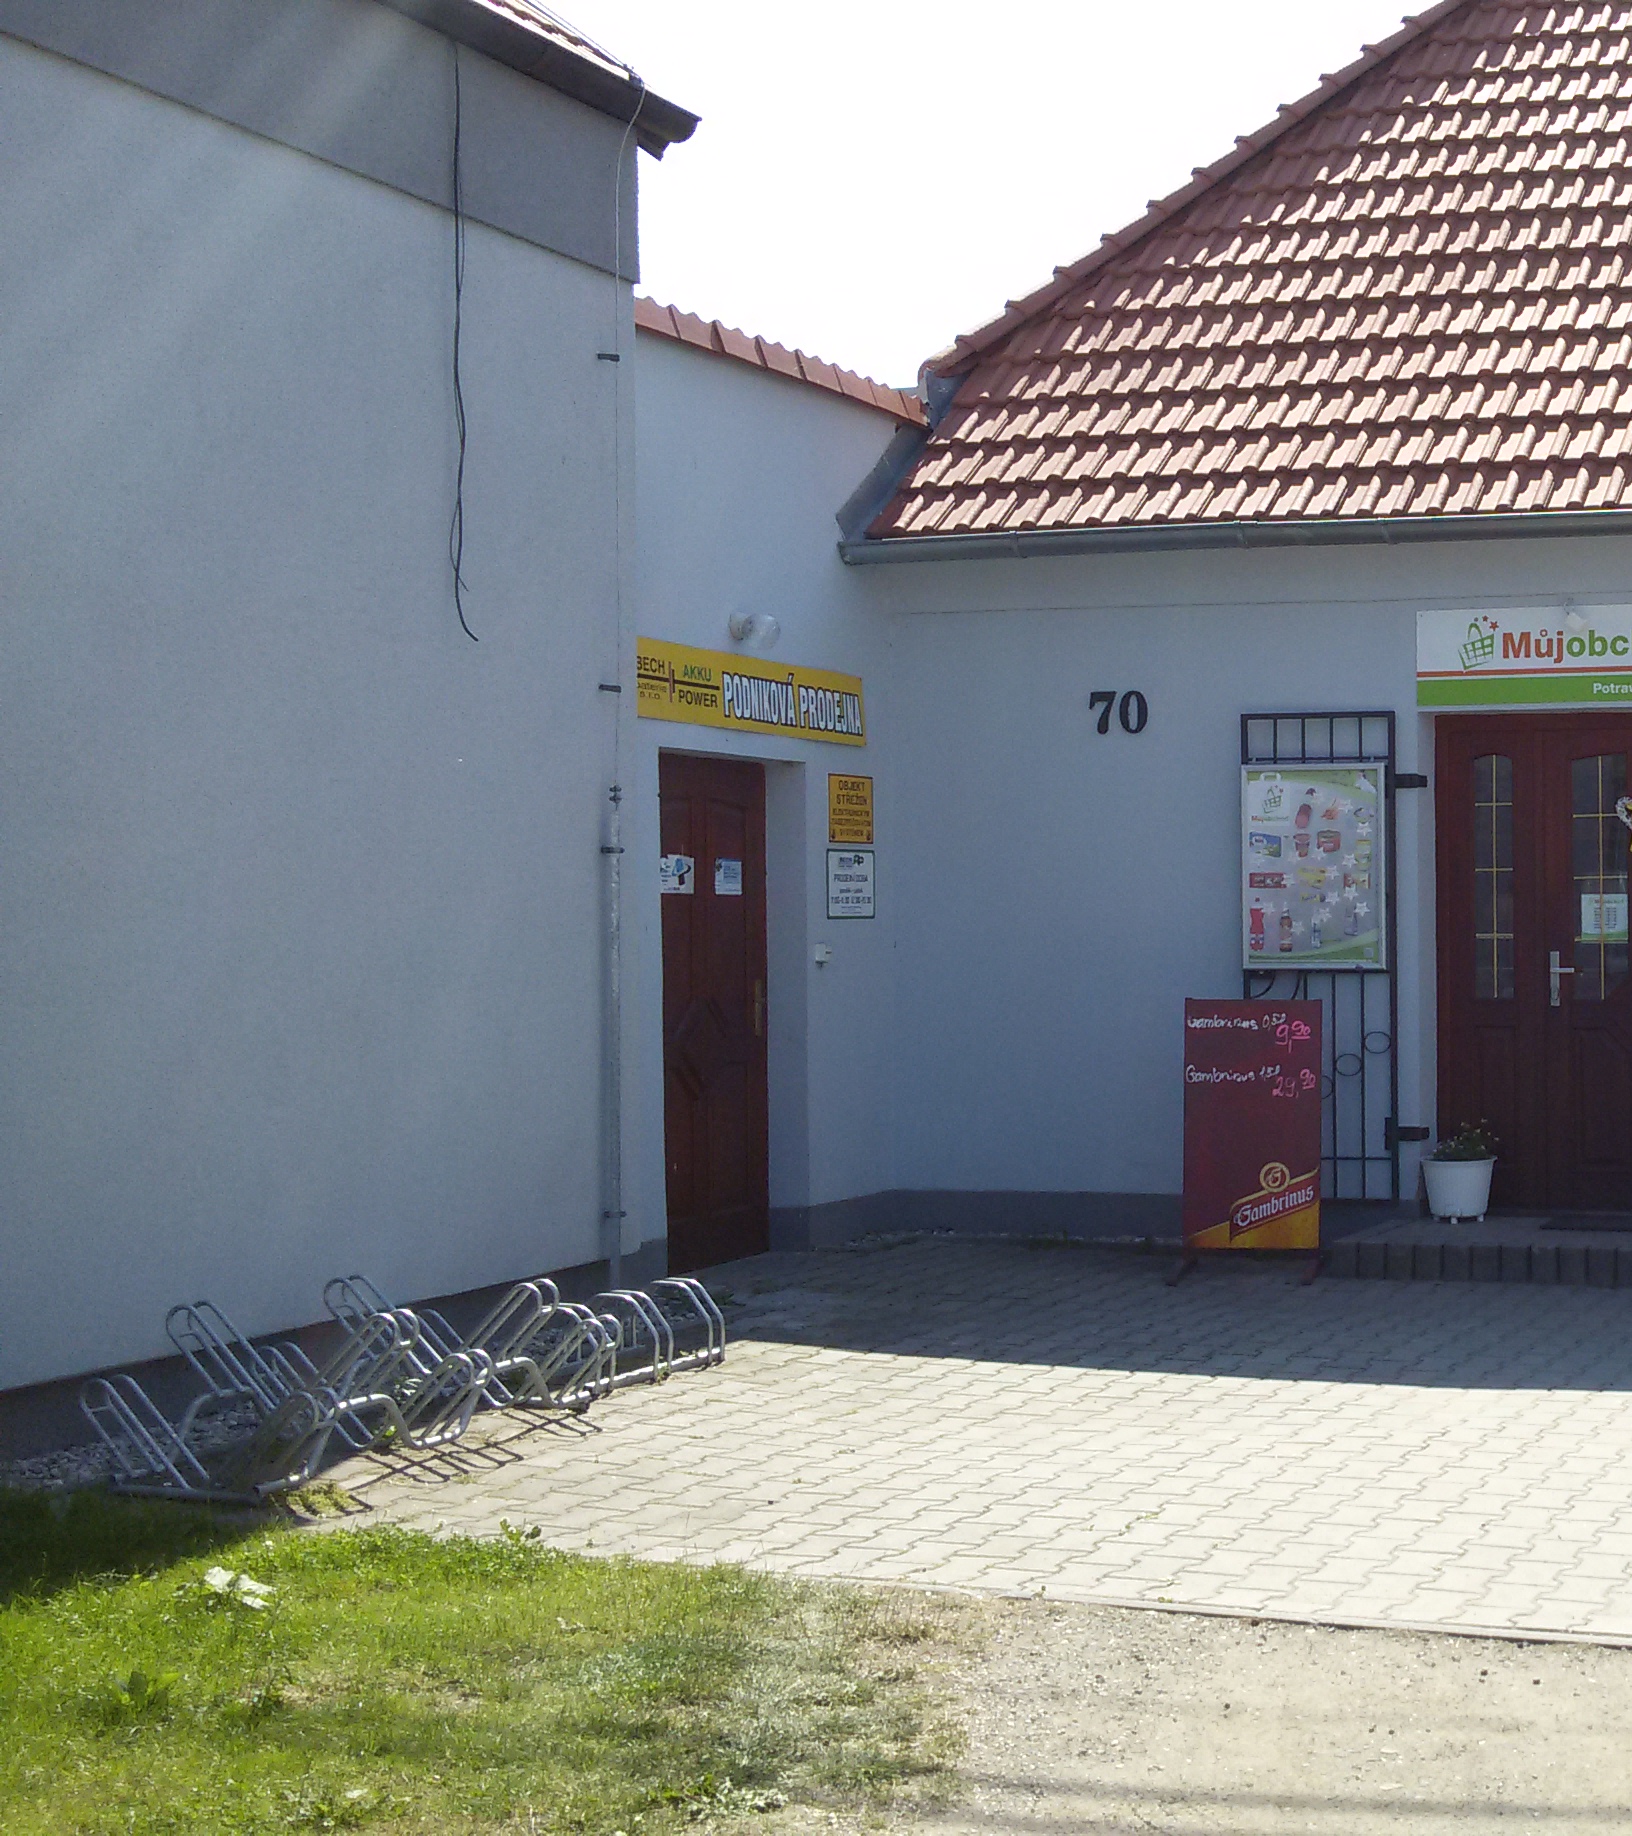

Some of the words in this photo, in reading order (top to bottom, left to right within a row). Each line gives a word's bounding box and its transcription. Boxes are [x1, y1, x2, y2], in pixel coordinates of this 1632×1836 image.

[682, 664, 712, 683] AKKU
[678, 689, 719, 708] POWER
[721, 673, 797, 728] PODNIKOVÁ
[798, 683, 864, 737] PRODEJNA
[1089, 690, 1148, 735] 70
[1233, 1184, 1315, 1227] Gambrinus
